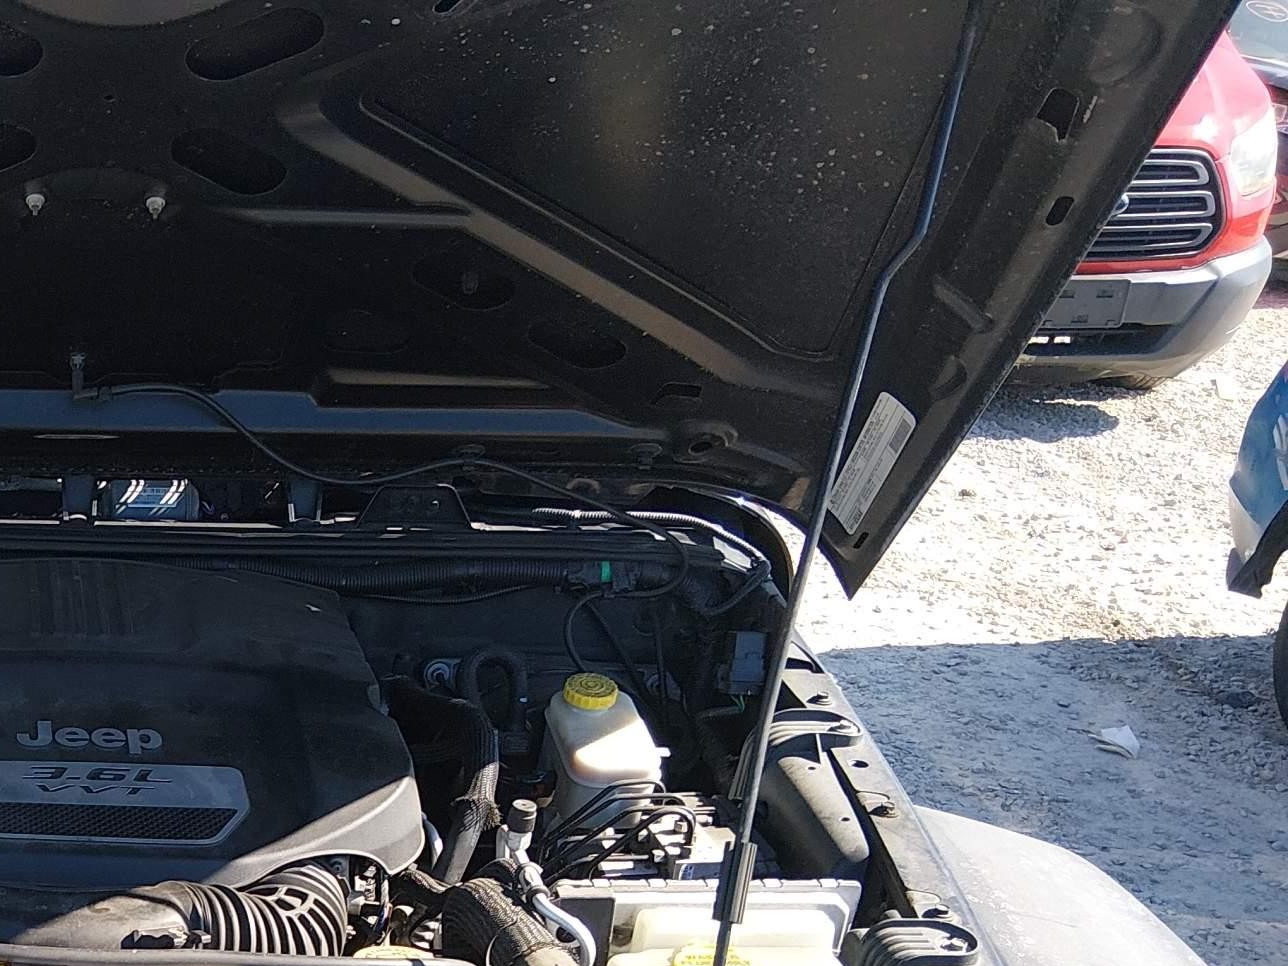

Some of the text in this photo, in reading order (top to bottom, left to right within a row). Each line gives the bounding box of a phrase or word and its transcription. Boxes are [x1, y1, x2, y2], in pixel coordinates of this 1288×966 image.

[16, 720, 162, 754] Jeep
[22, 766, 173, 783] 3.6L
[35, 783, 156, 796] VVT
